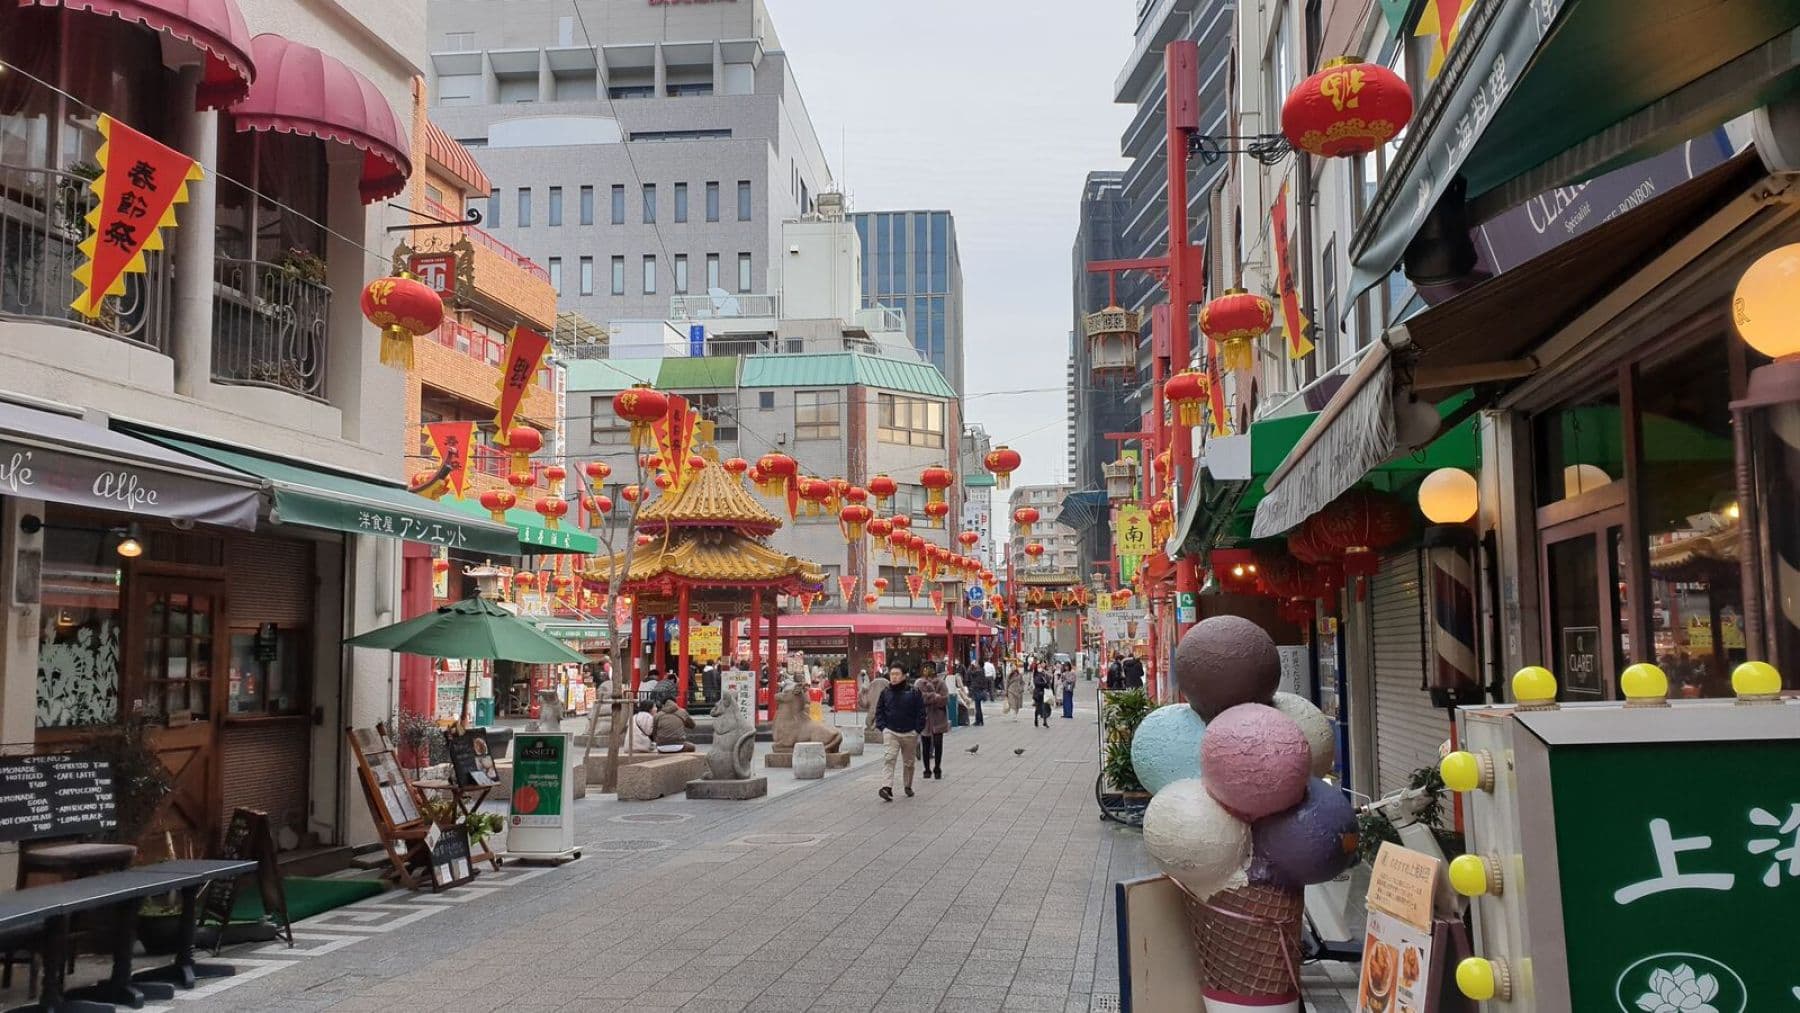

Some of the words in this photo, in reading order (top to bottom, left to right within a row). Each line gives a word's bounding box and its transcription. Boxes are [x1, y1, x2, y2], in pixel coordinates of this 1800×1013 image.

[92, 472, 159, 510] Alfee
[358, 511, 395, 533] 洋食屋
[400, 516, 467, 547] アシエット
[1125, 525, 1144, 543] 南
[1569, 654, 1594, 672] CLARET
